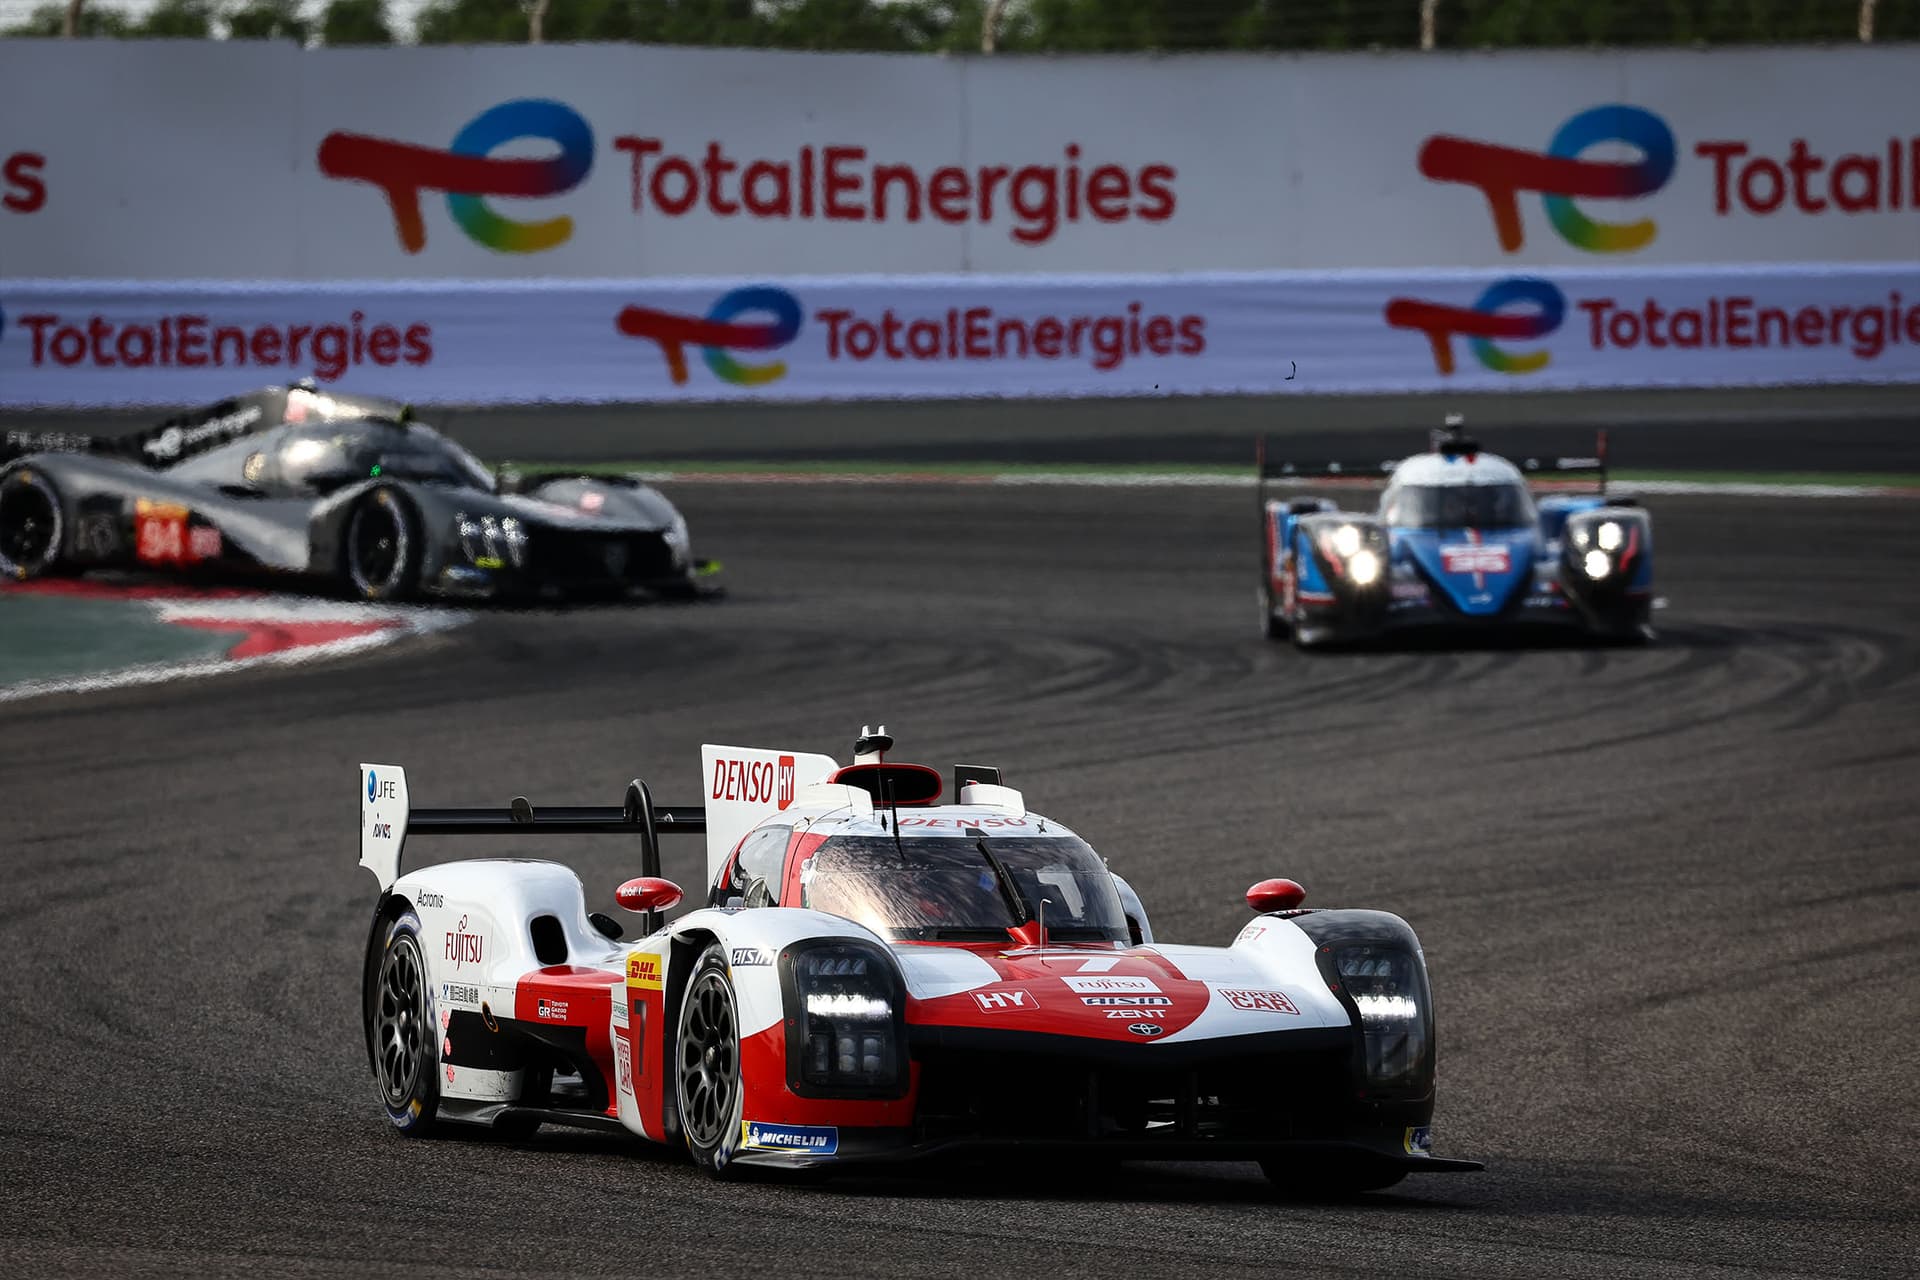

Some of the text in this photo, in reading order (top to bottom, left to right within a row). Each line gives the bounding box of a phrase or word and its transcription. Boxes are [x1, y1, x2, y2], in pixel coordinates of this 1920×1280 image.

[1695, 137, 1920, 215] Total
[613, 136, 1177, 243] TotalEnergies
[816, 302, 1206, 370] TotalEnergies
[19, 312, 432, 380] TotalEnergies
[377, 780, 396, 799] JFE
[713, 759, 794, 804] DENSO HY
[898, 817, 1027, 828] DENSO
[416, 888, 444, 909] Acronis
[445, 931, 483, 971] FUJITSU
[631, 960, 657, 980] DHL
[1040, 956, 1121, 973] 7
[1078, 979, 1146, 990] FUJITSU
[975, 991, 1024, 1009] HY
[1086, 996, 1168, 1005] AISIN
[1224, 991, 1283, 1000] HYPER
[1231, 996, 1294, 1012] CAR
[538, 1006, 551, 1017] GR
[1102, 1009, 1167, 1019] ZENT
[761, 1132, 828, 1147] MICHELIN
